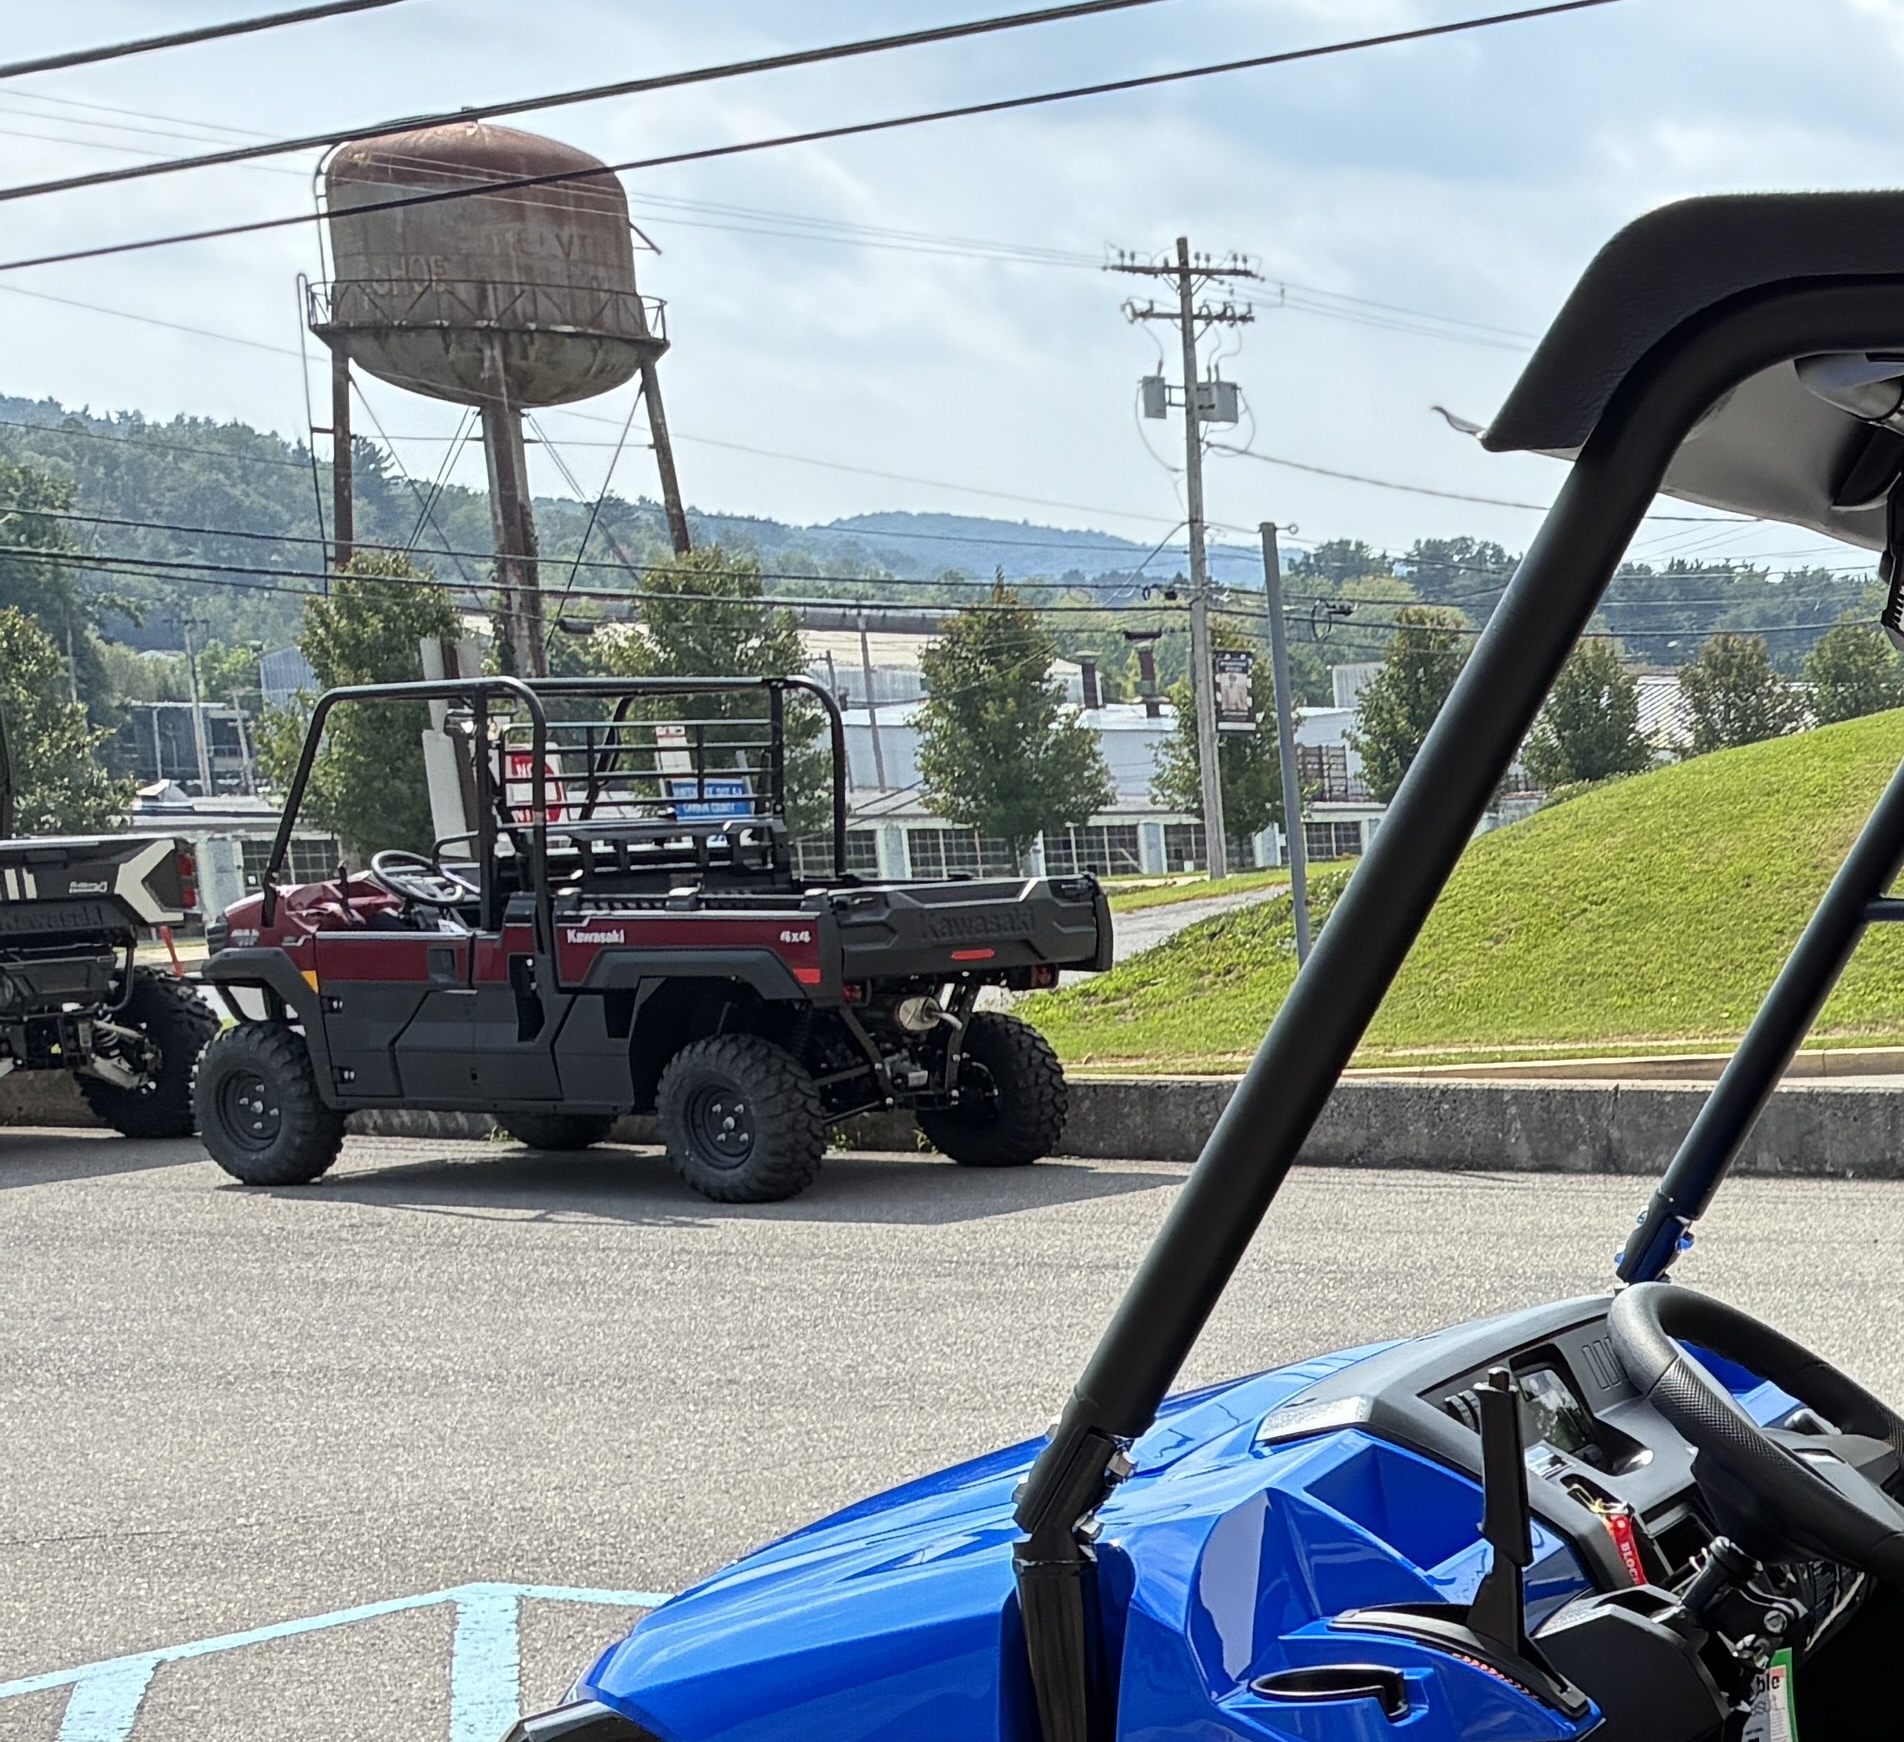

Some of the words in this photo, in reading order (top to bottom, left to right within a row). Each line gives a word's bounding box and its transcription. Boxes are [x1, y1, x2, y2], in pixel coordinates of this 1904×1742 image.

[920, 905, 1037, 940] Kawasaki
[566, 928, 625, 944] Kawasaki
[780, 930, 812, 943] 4x4
